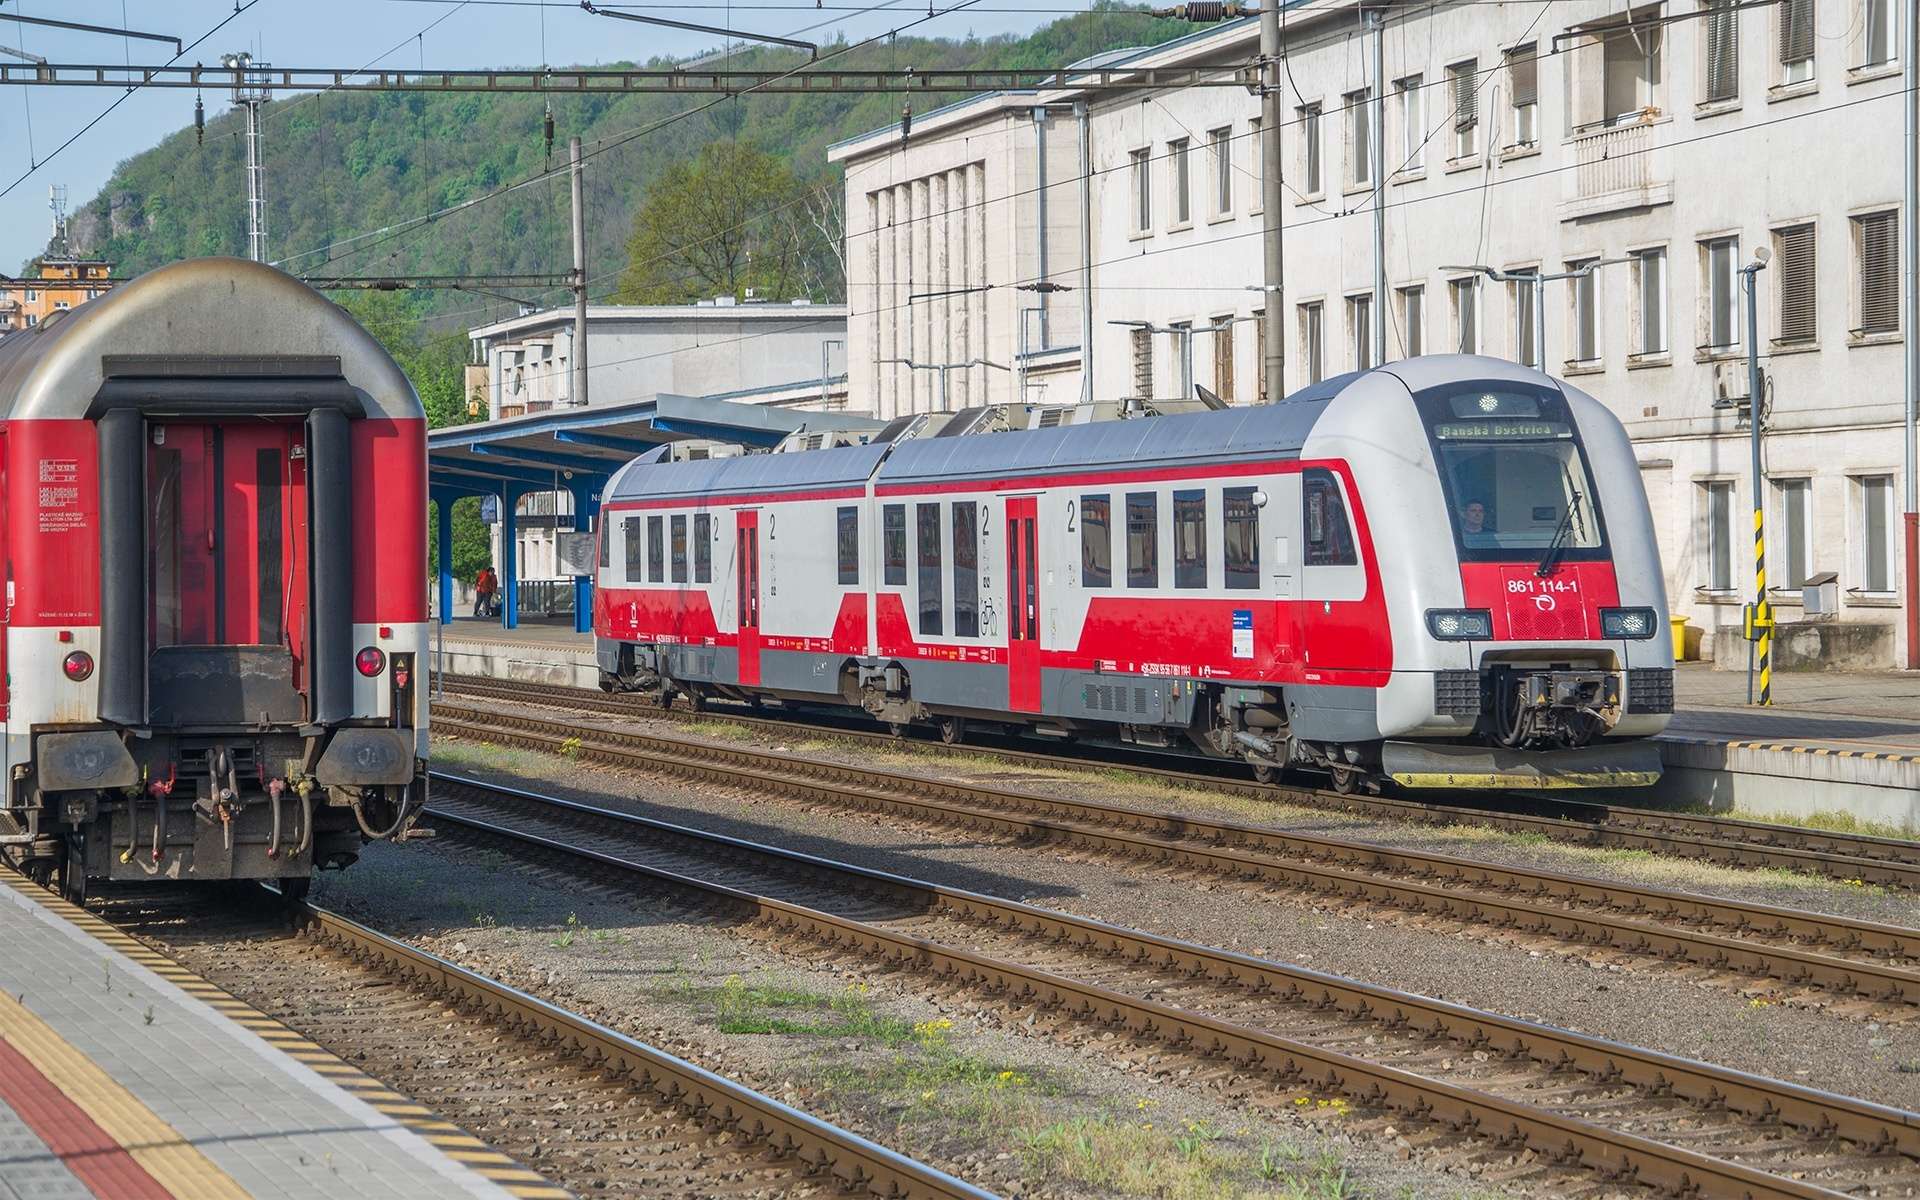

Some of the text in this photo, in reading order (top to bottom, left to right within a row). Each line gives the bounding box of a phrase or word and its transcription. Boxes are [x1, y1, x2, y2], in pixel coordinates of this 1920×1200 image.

[1442, 424, 1552, 436] Banská Bystrica
[713, 516, 719, 541] 2
[770, 513, 776, 540] 2
[982, 505, 989, 536] 2
[1067, 500, 1075, 532] 2
[1507, 580, 1578, 593] 861 114-1
